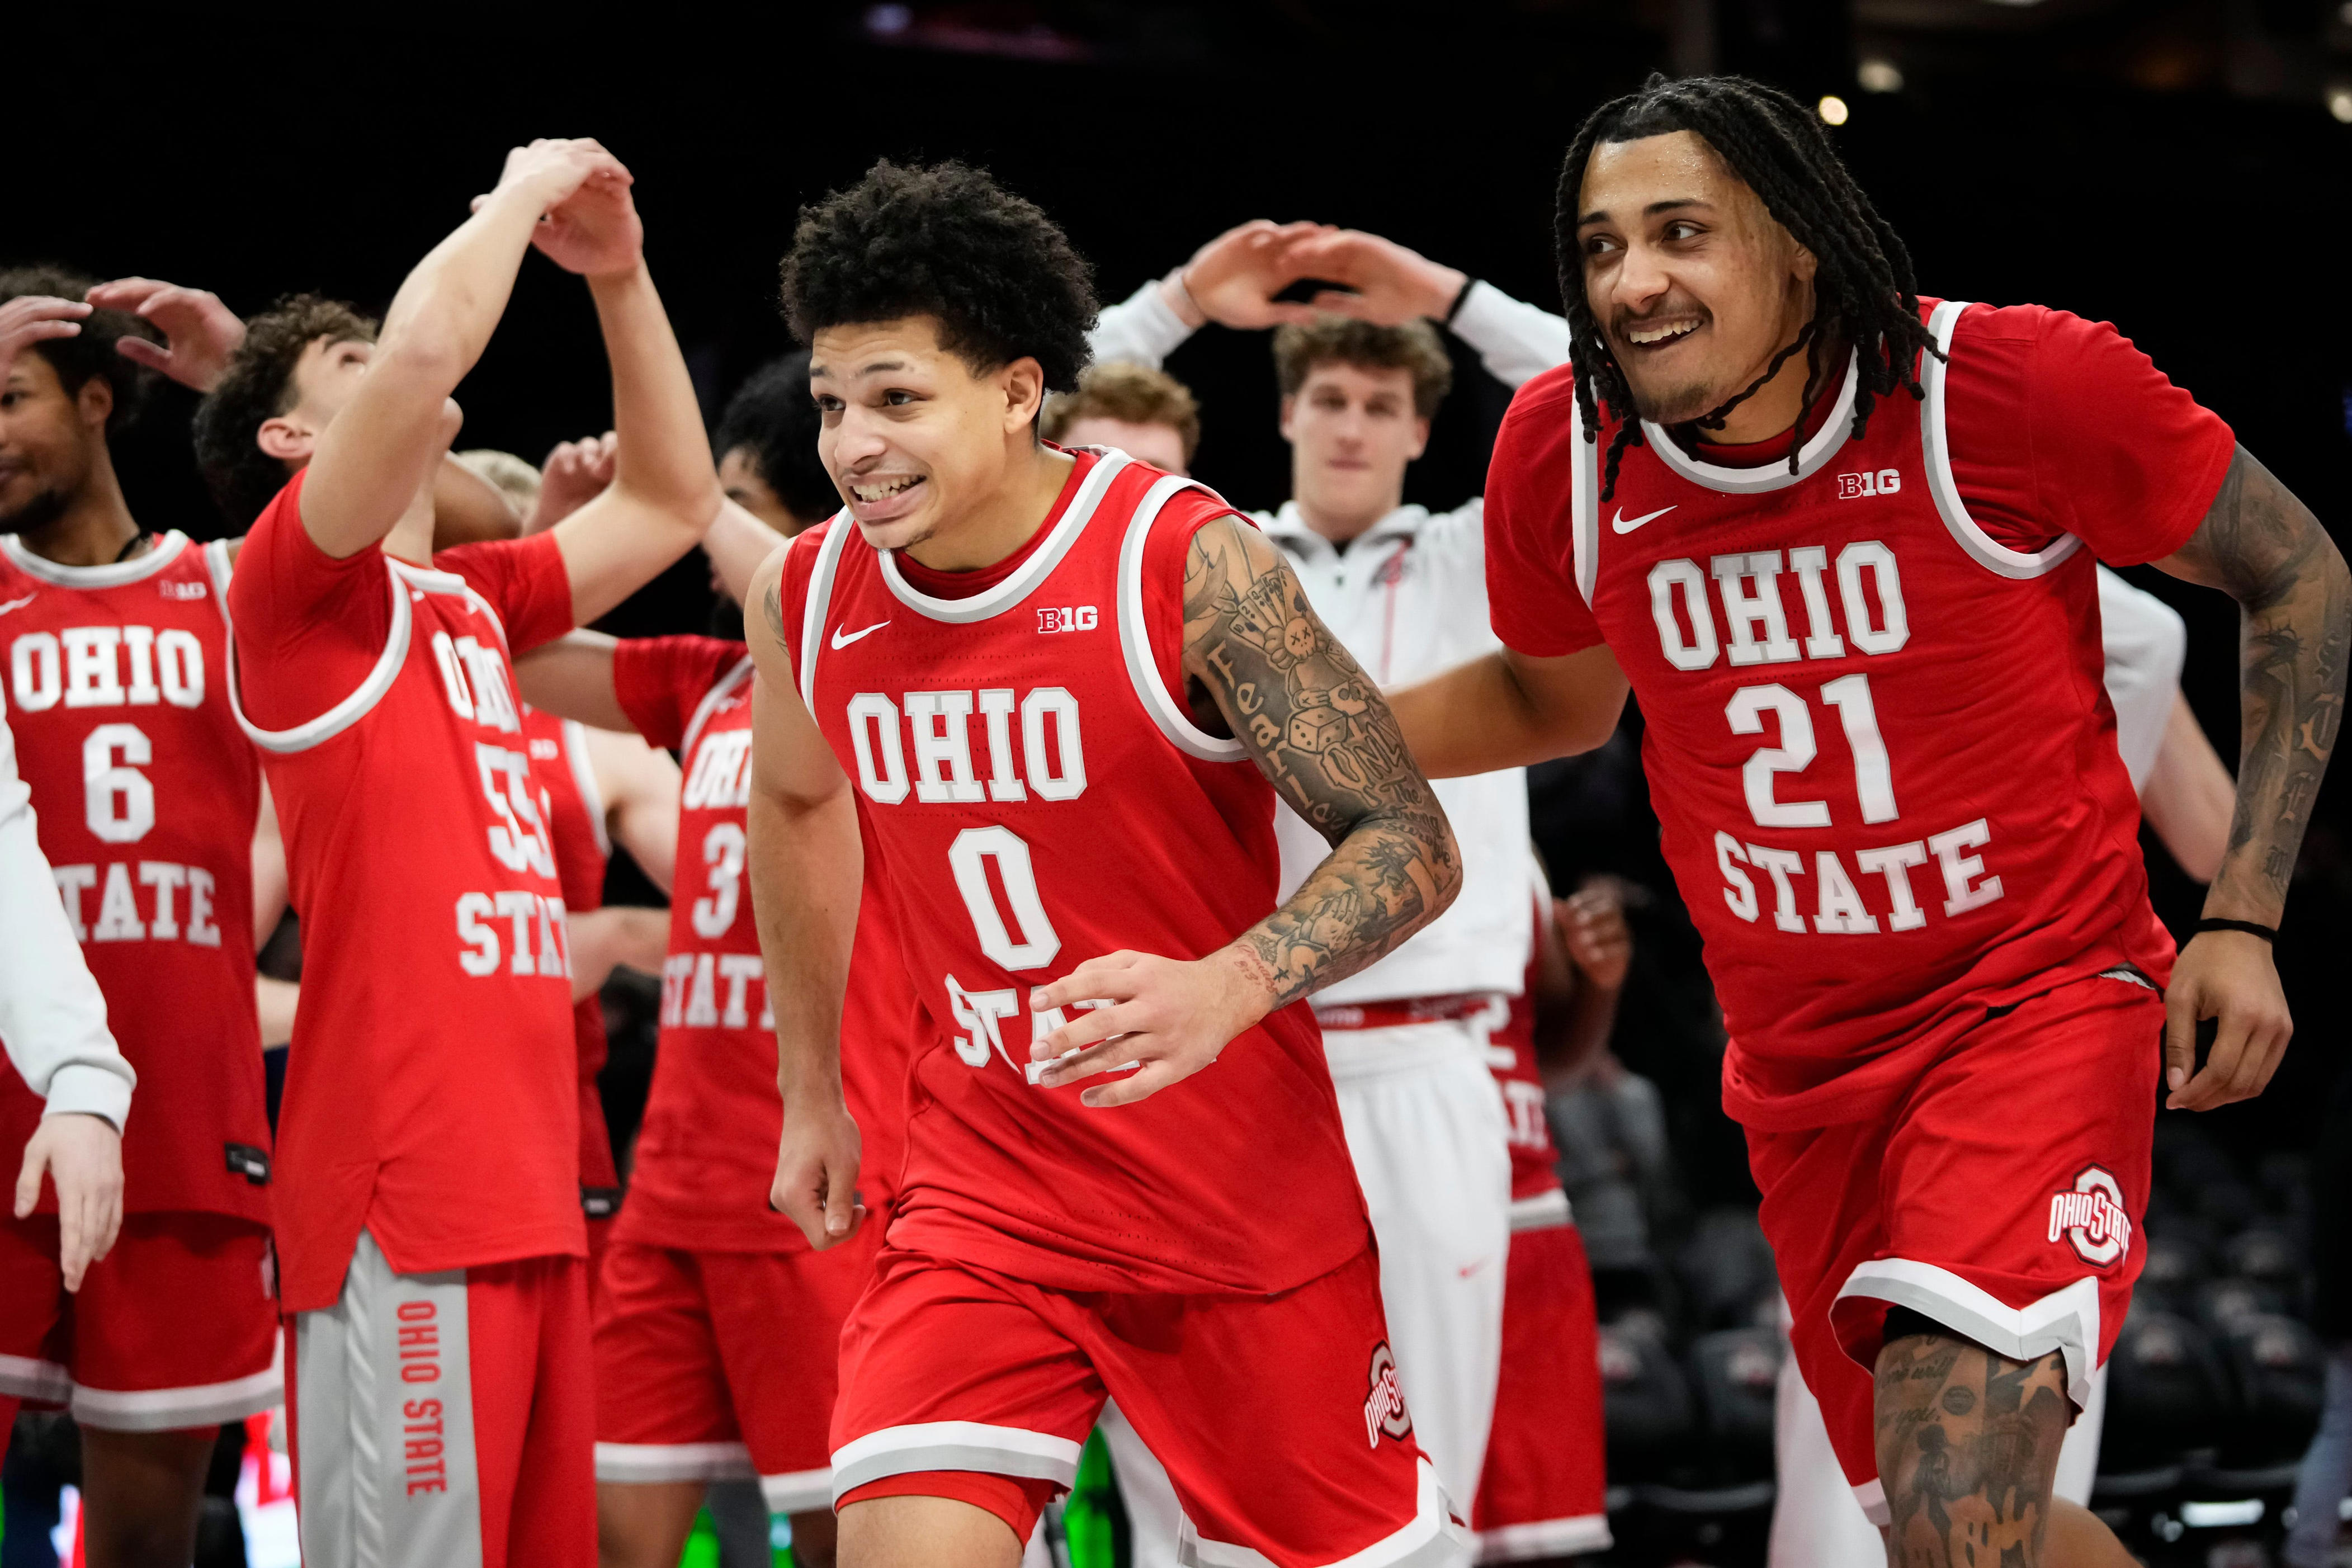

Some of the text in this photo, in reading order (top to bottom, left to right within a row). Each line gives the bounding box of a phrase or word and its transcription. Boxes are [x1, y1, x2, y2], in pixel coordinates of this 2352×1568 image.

[1037, 605, 1098, 634] B1G
[1646, 540, 1911, 671] OHIO
[11, 625, 205, 713] OHIO
[82, 722, 155, 843] 6
[682, 728, 753, 810] OHI
[847, 686, 1088, 805] OHIO
[1723, 673, 1900, 828] 21
[475, 741, 558, 880] 55
[53, 861, 222, 947] TATE
[691, 822, 747, 939] 3
[947, 824, 1062, 972] 0
[1714, 818, 2005, 934] STATE
[397, 1300, 447, 1497] OHIO STATE
